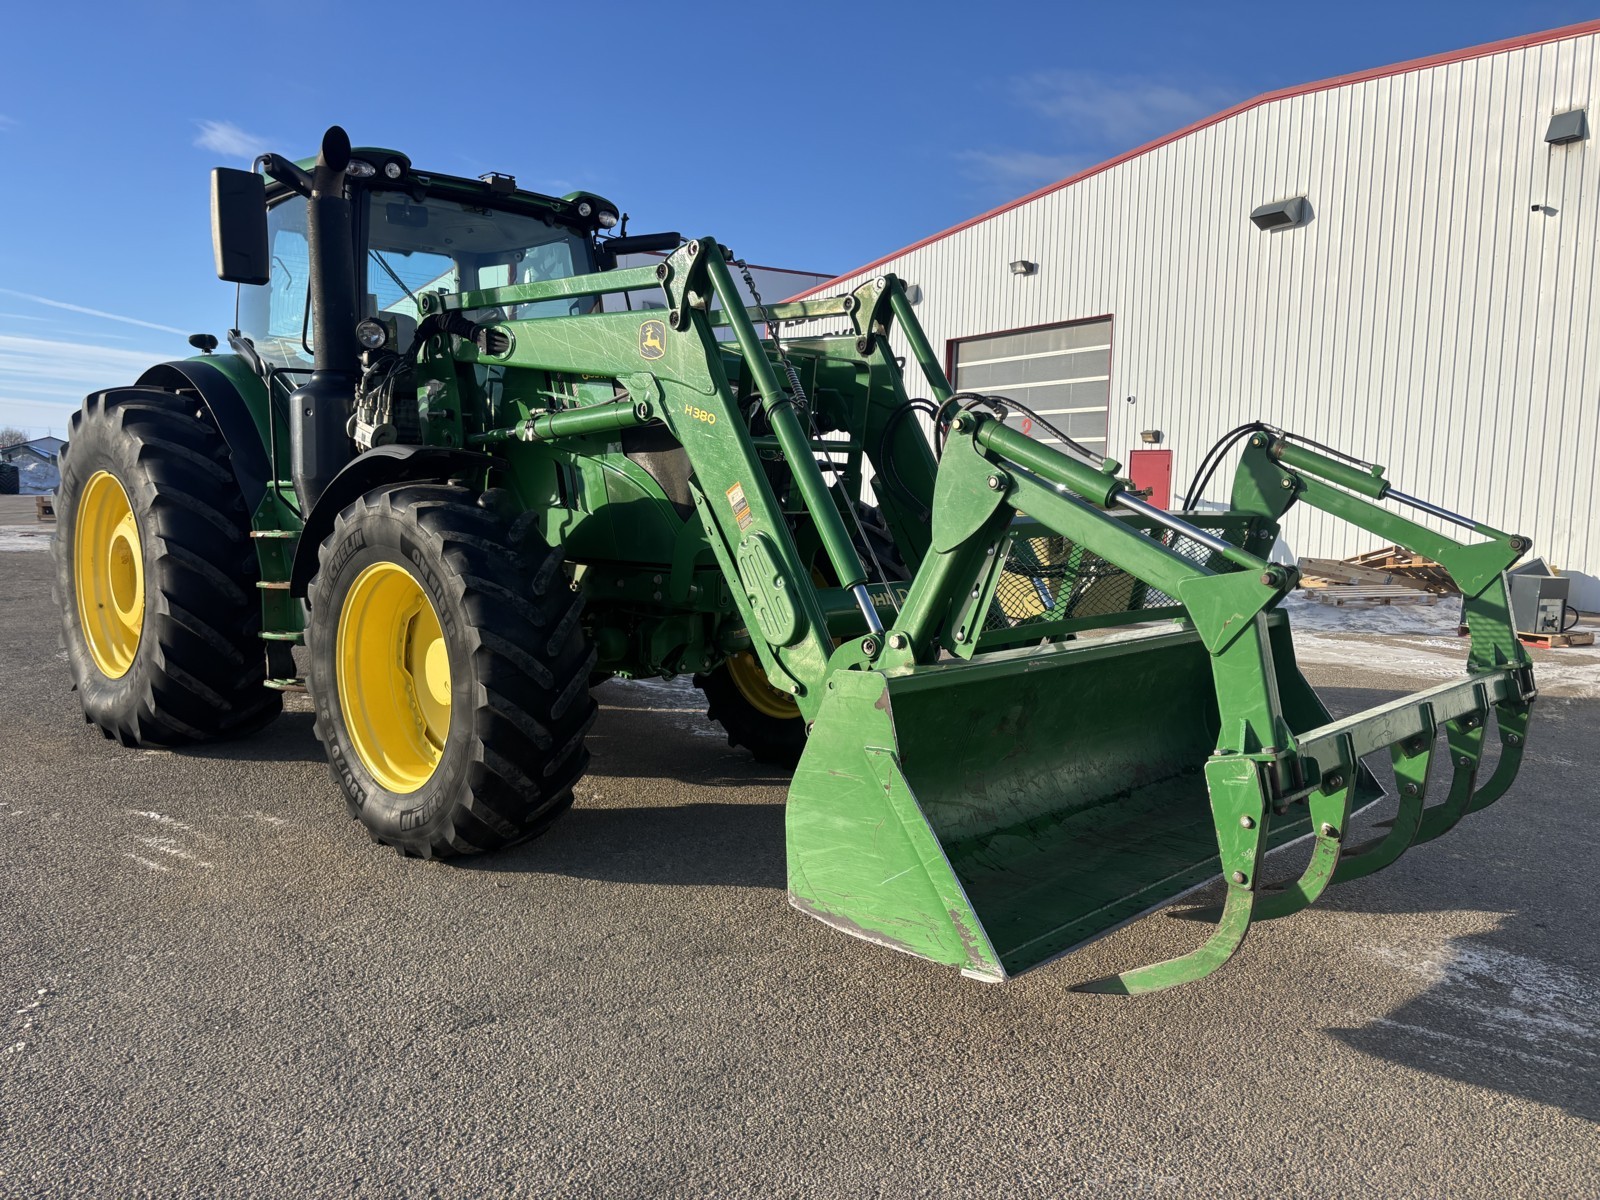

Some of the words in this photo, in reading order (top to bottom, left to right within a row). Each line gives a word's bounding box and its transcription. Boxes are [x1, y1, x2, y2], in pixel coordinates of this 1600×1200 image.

[684, 404, 716, 425] H380
[1021, 417, 1033, 438] 2
[320, 528, 364, 602] MICHELIN
[411, 547, 455, 638] OMNIBIB
[325, 727, 336, 742] R
[331, 743, 364, 807] 480/70
[401, 761, 455, 830] MICHELIN
